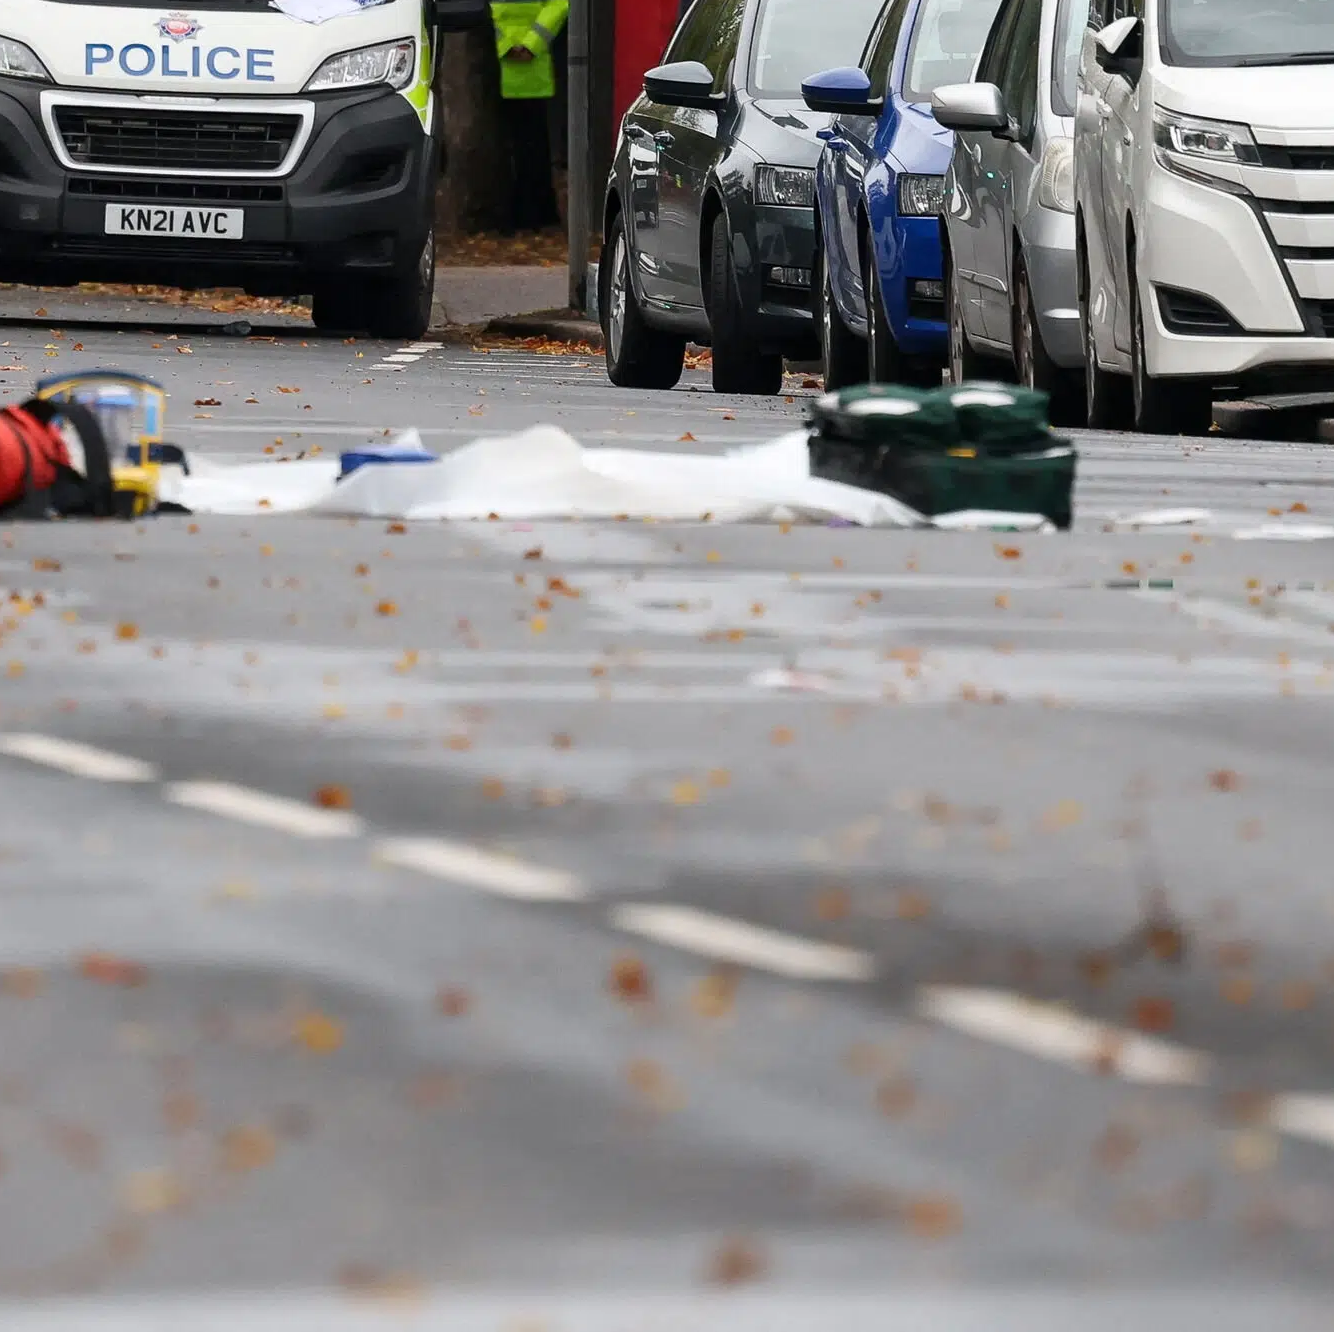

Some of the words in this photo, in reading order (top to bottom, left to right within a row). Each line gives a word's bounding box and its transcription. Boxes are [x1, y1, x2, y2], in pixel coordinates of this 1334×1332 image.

[85, 43, 275, 82] POLICE
[121, 208, 174, 232] KN21
[182, 211, 228, 234] AVC
